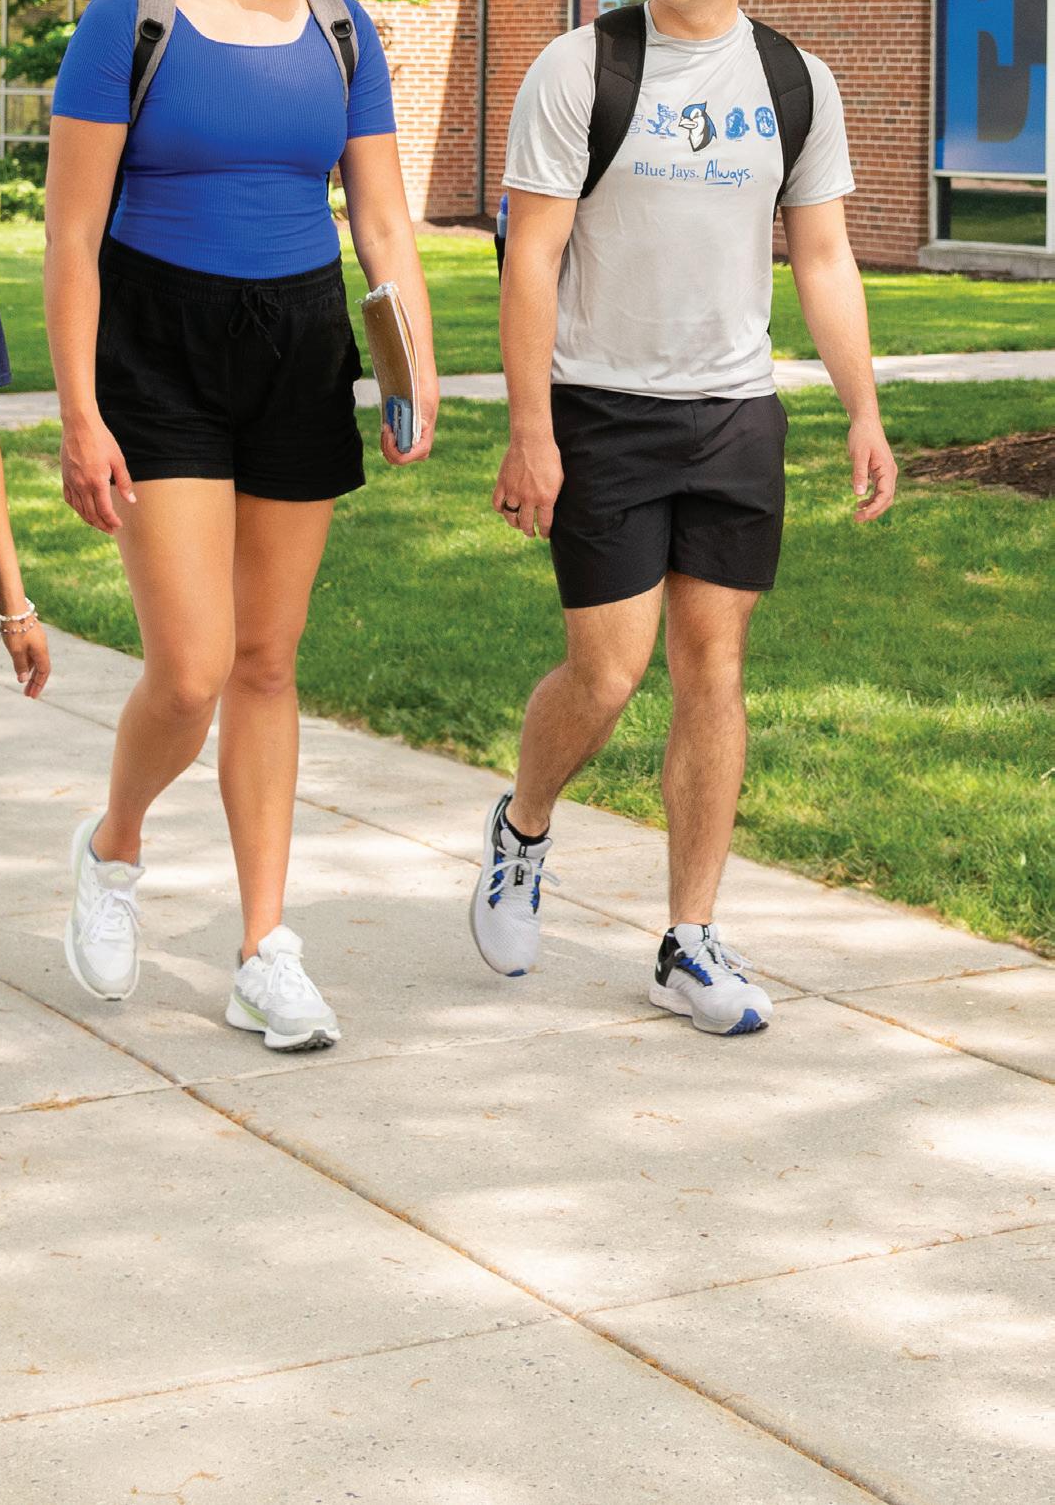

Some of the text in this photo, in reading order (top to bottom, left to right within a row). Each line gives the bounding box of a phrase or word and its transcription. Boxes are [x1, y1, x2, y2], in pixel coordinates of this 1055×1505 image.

[633, 159, 754, 188] Blue Jays. Always.
